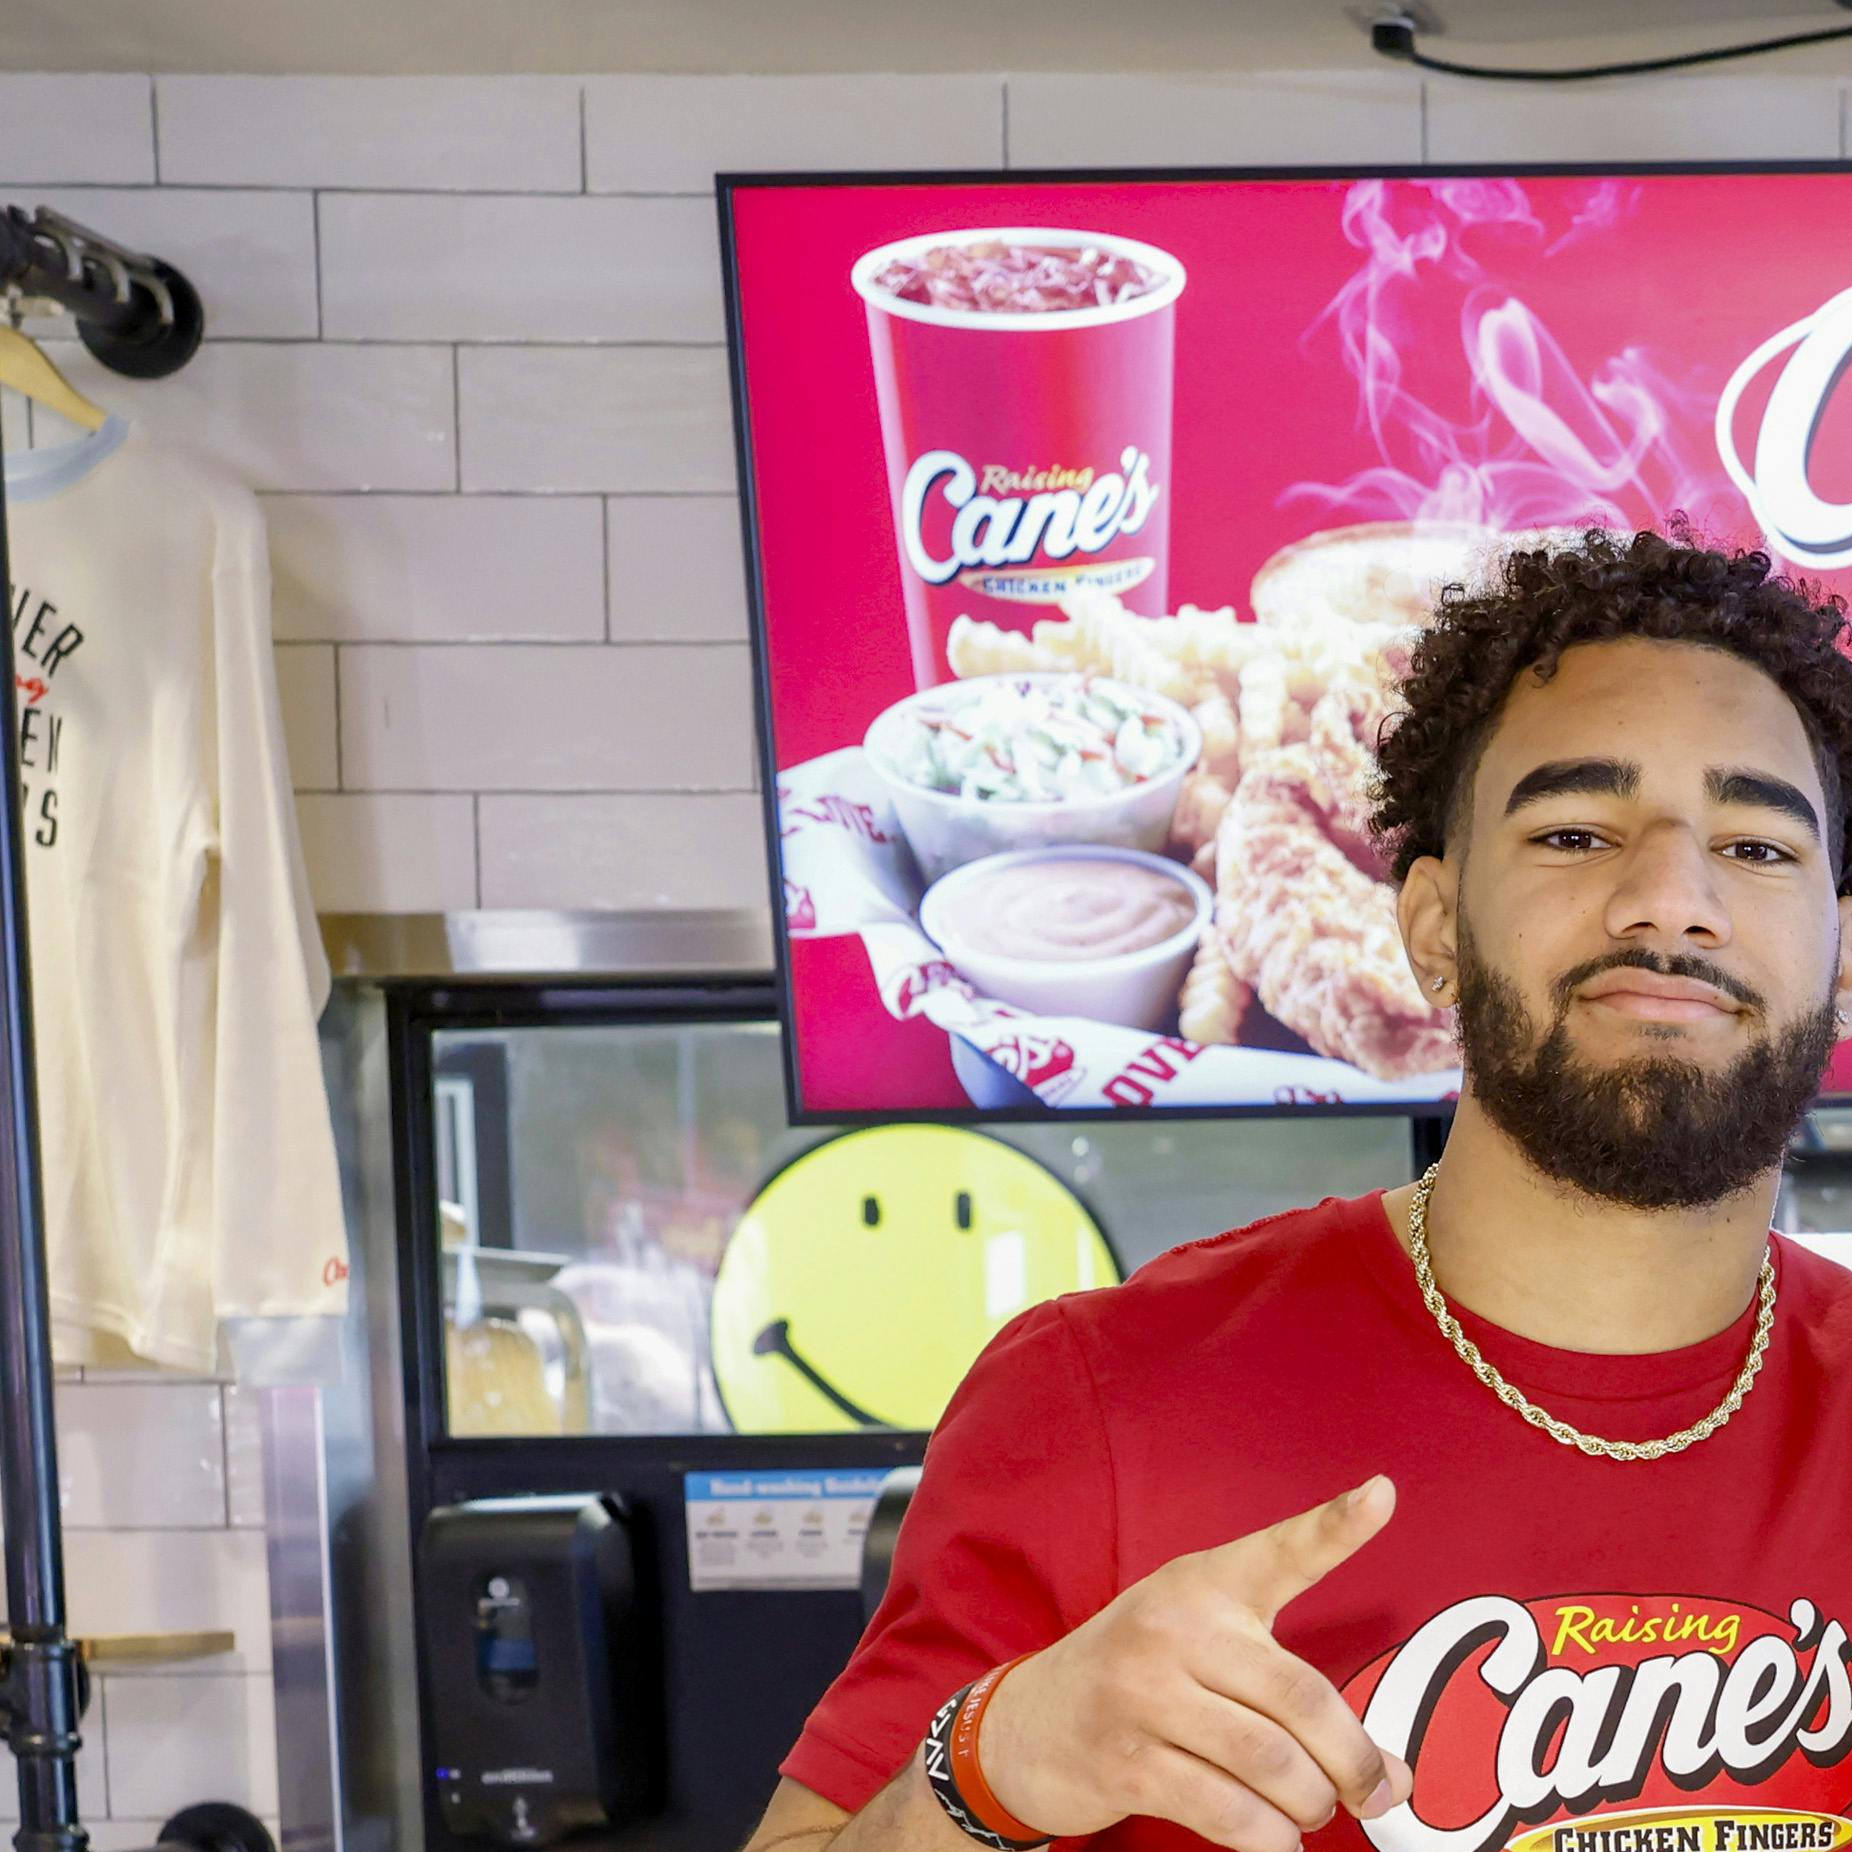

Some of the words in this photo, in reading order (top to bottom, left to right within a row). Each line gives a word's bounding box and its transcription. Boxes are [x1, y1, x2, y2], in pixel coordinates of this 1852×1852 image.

[980, 463, 1096, 495] Raising
[902, 445, 1160, 586] Cane's
[1551, 1602, 1742, 1658] Raising
[1714, 1819, 1836, 1852] FINGERS
